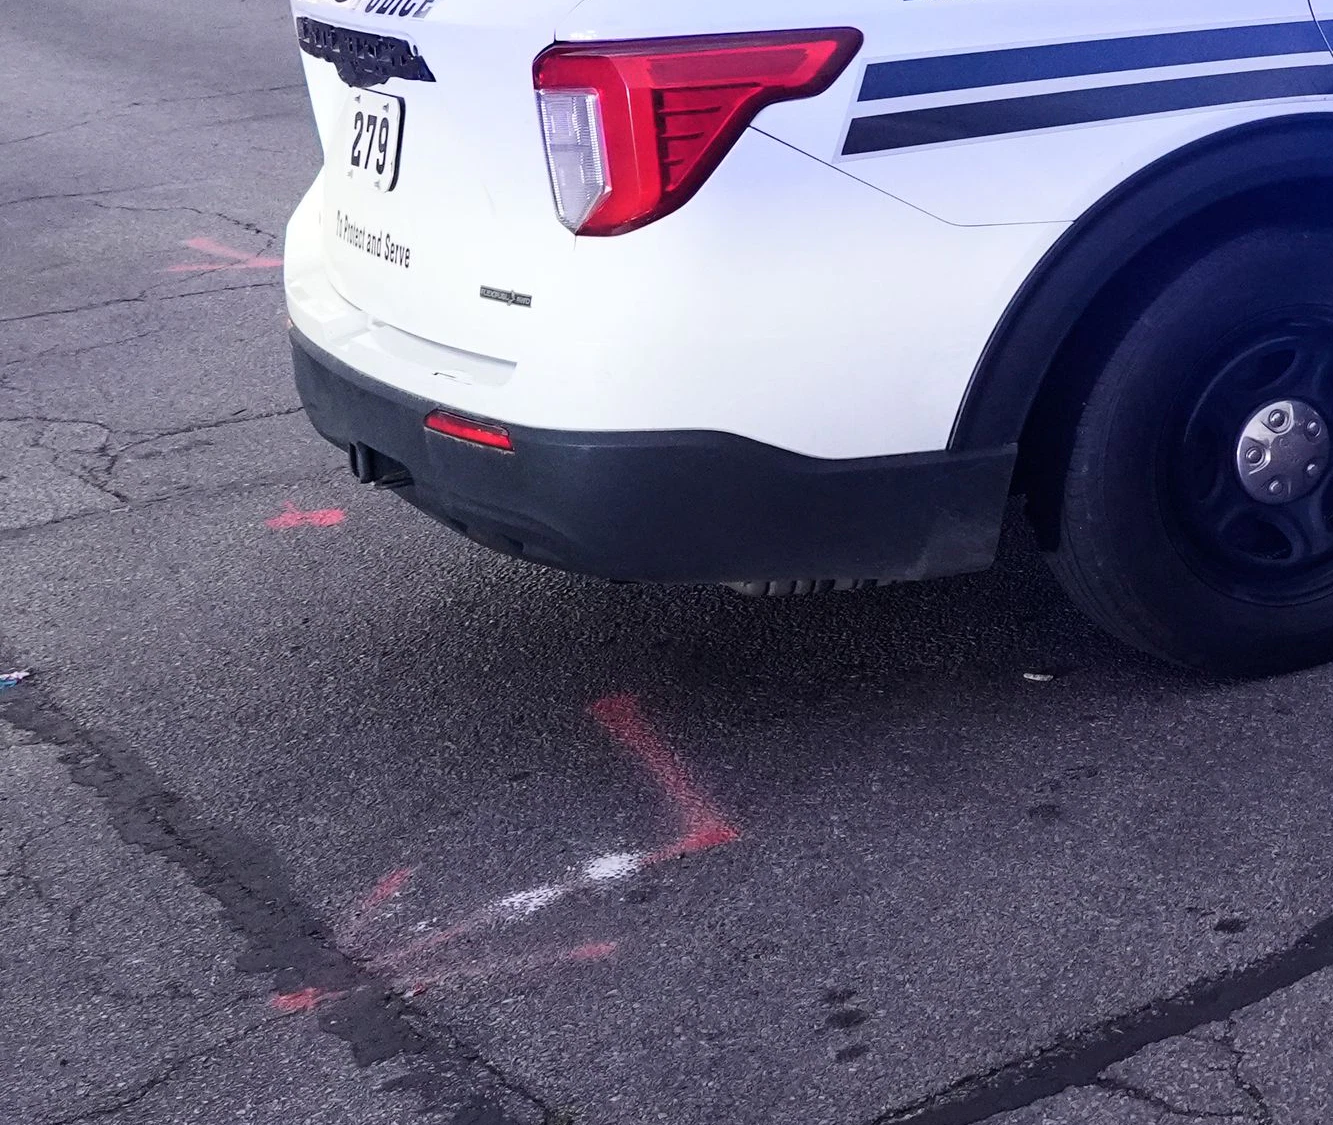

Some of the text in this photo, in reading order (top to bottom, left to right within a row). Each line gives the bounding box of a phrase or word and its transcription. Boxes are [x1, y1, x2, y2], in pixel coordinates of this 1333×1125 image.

[350, 110, 390, 176] 279
[336, 209, 411, 269] To Protect and Serve
